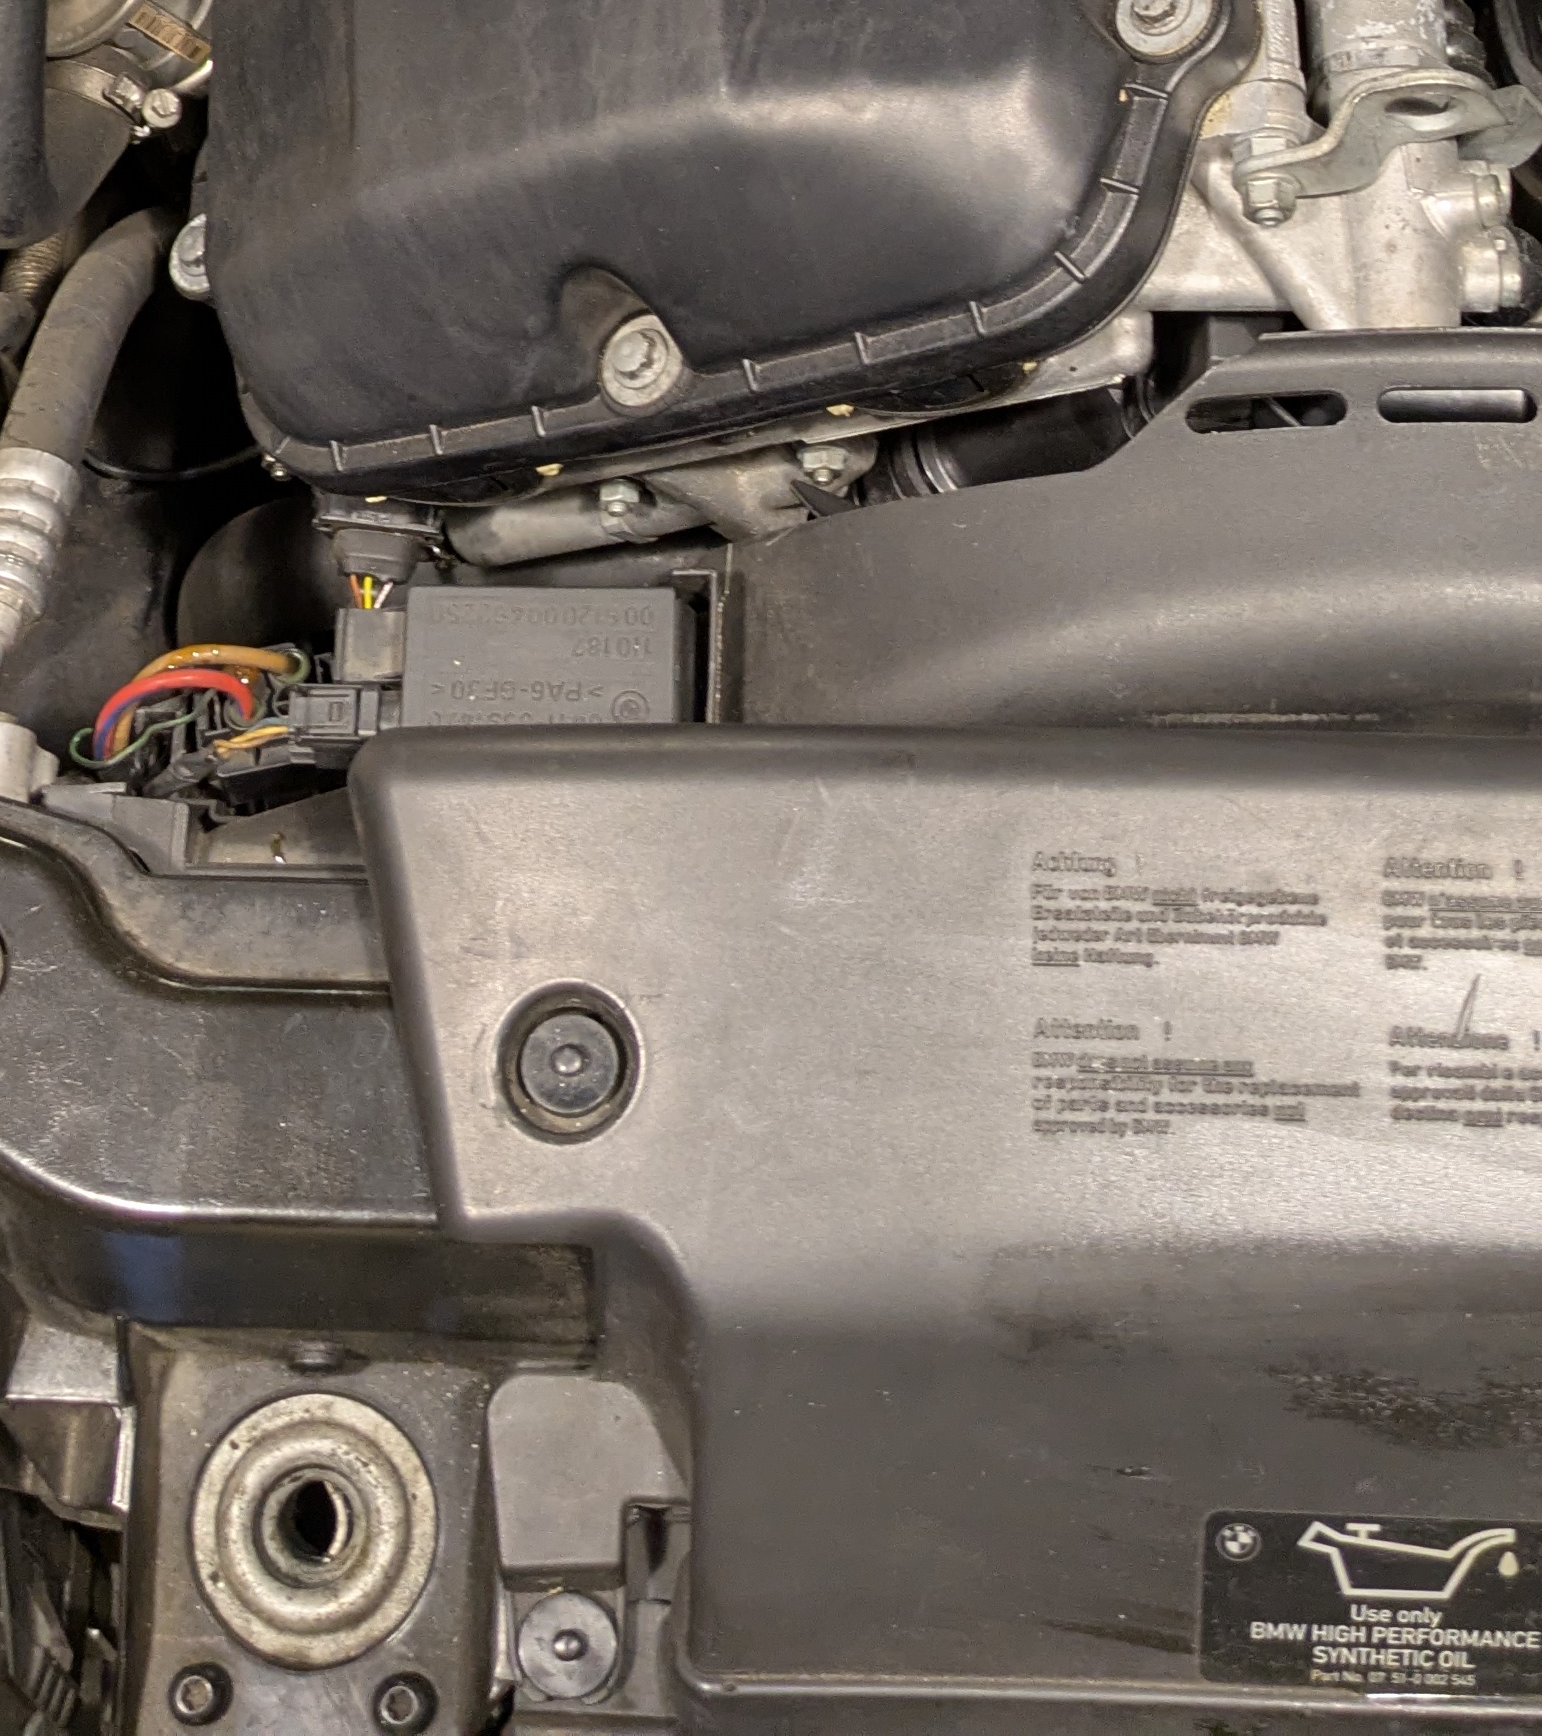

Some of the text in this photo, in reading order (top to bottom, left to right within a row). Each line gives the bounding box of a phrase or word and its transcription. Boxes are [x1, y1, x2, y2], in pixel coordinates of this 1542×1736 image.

[1383, 857, 1493, 879] Attention
[1033, 1017, 1140, 1040] Attention
[1350, 1604, 1443, 1628] Use only
[1250, 1622, 1542, 1649] BMW HIGH PERFORMANCE
[1312, 1647, 1477, 1669] SYNTHETIC OIL
